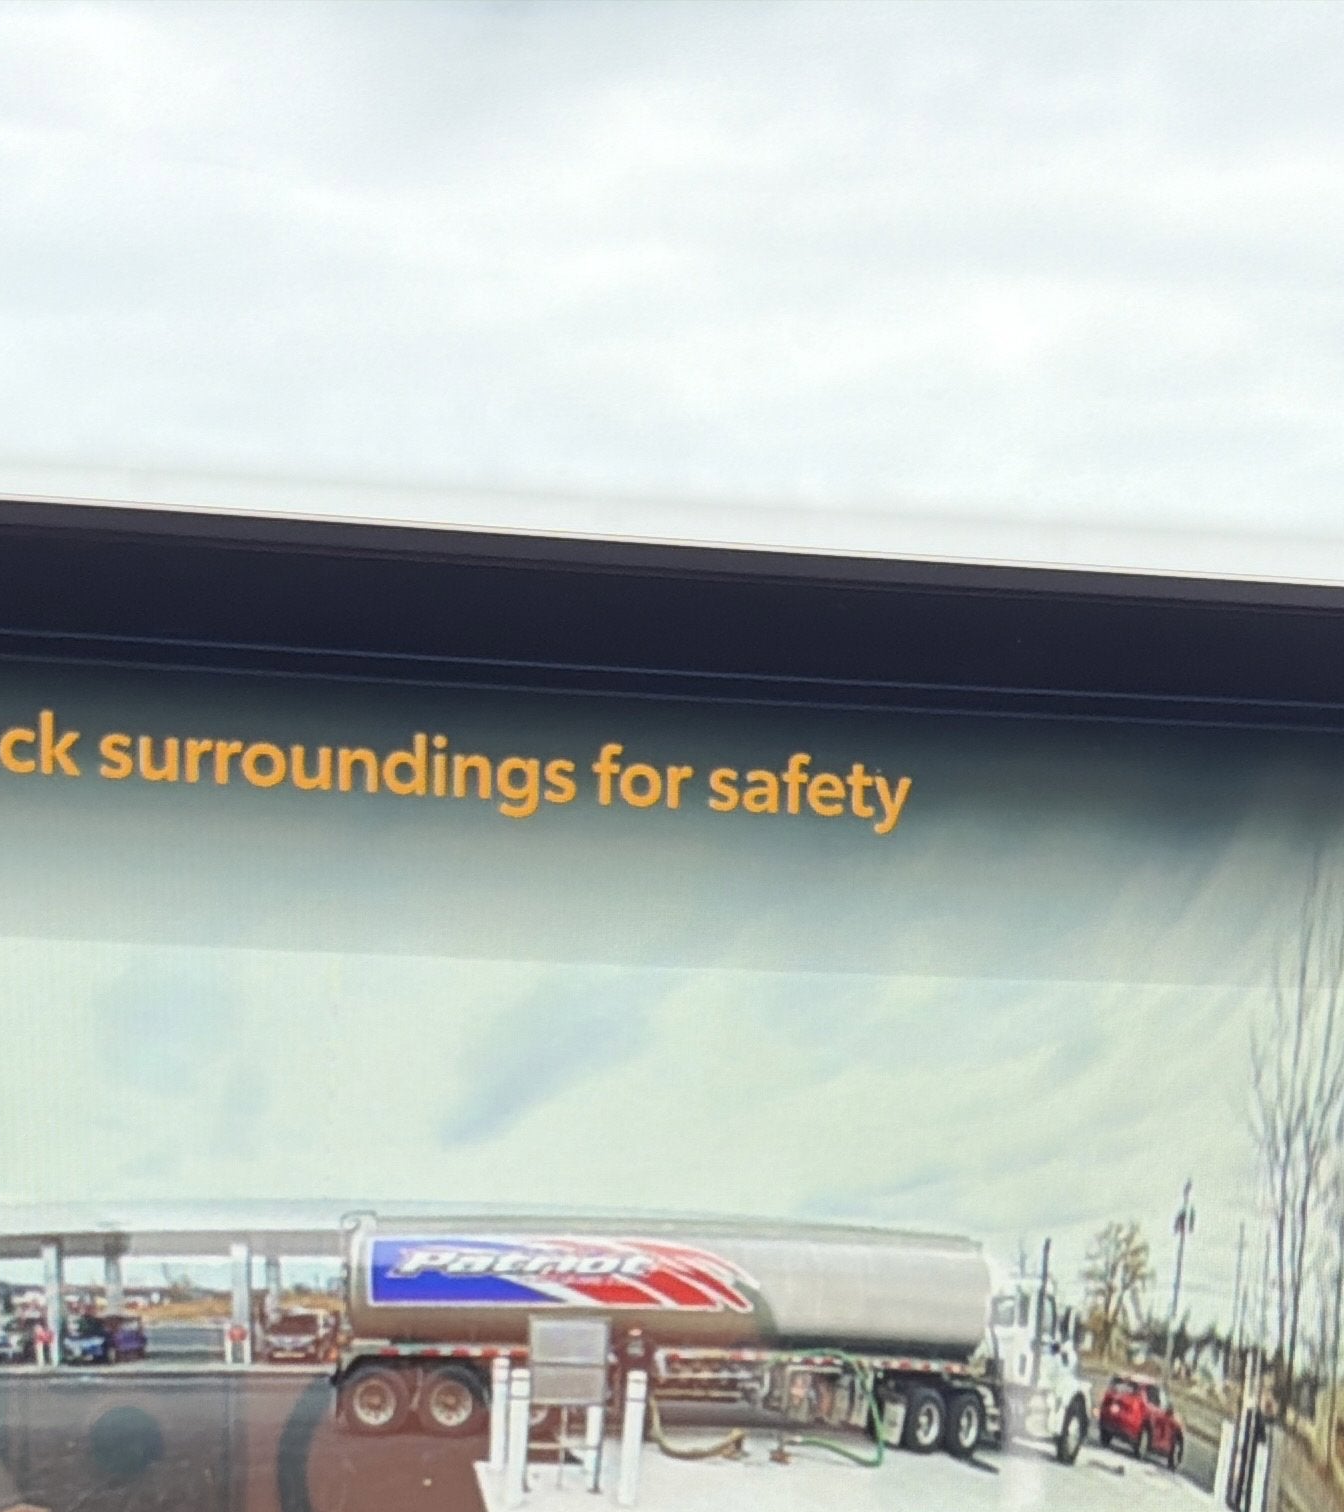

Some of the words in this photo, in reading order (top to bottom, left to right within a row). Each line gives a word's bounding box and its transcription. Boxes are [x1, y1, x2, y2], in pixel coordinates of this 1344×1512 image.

[99, 733, 578, 819] surroundings
[592, 743, 695, 810] for
[710, 753, 913, 835] safety
